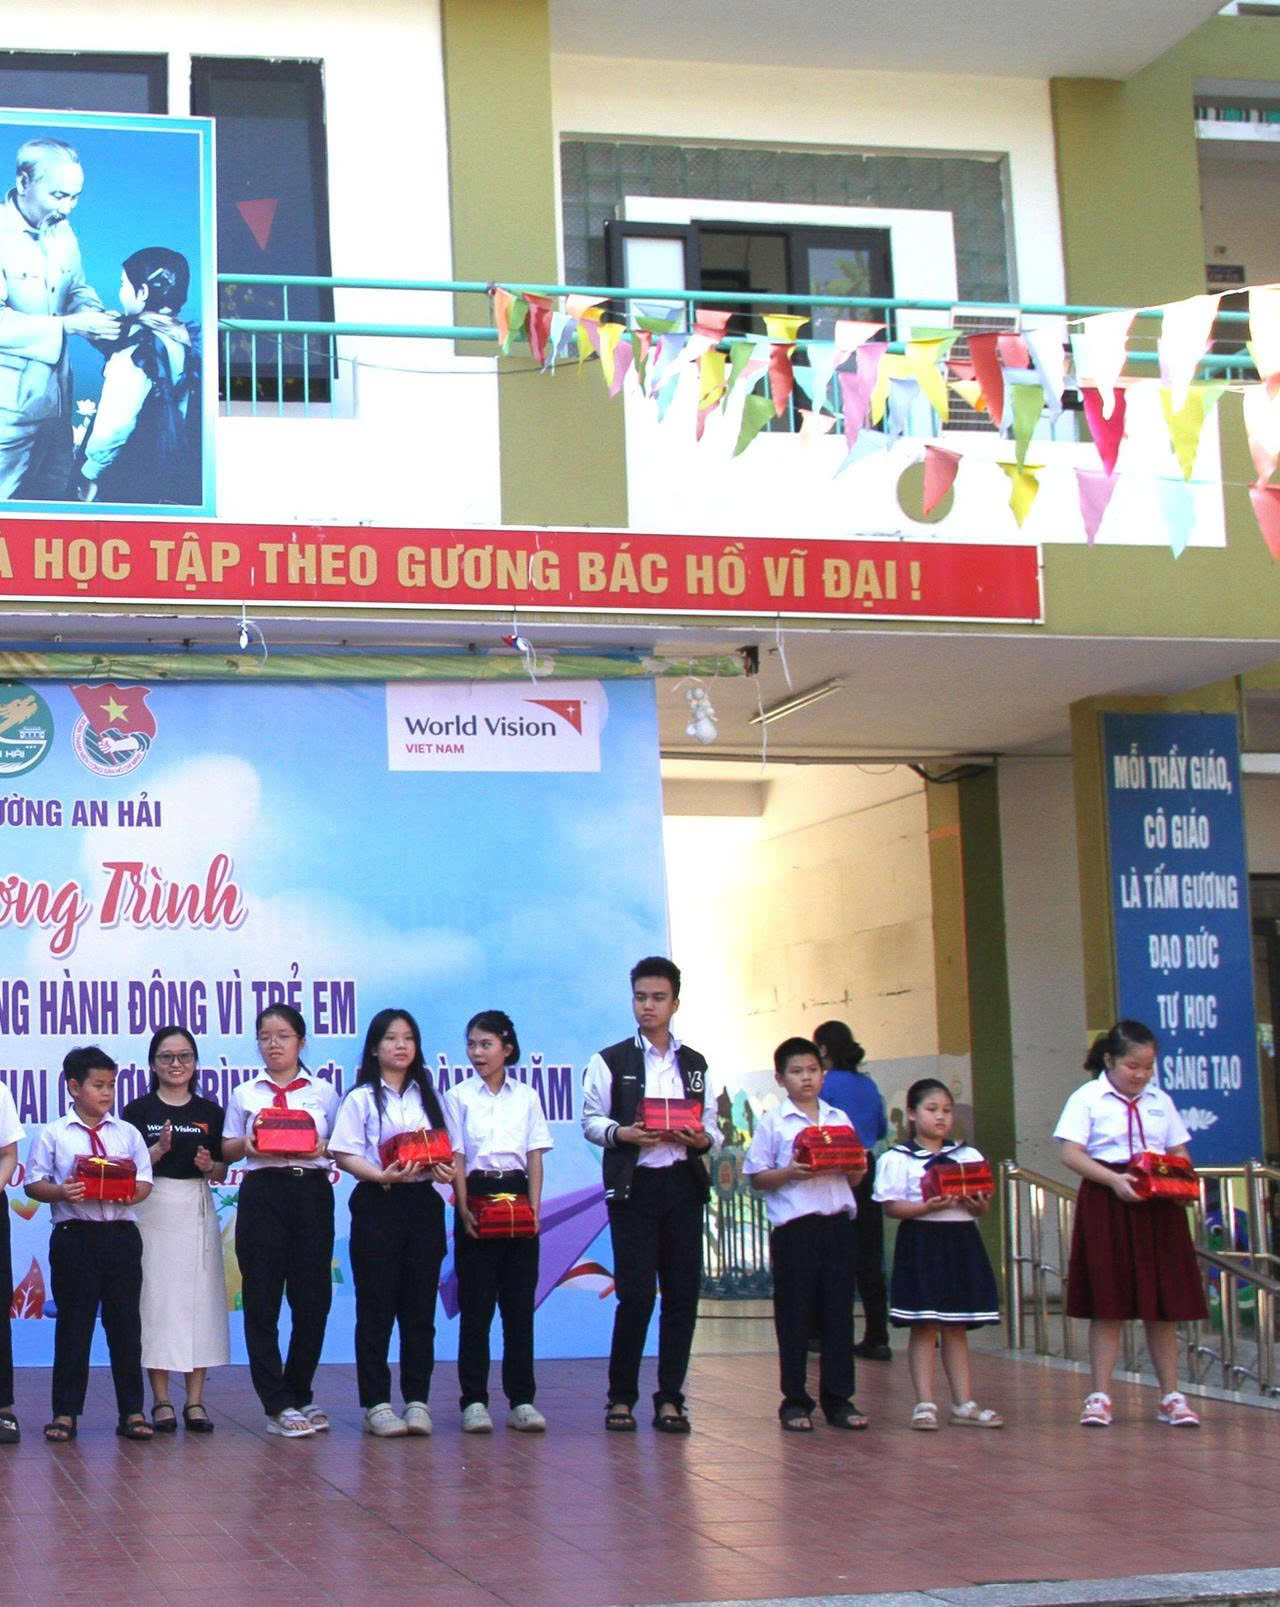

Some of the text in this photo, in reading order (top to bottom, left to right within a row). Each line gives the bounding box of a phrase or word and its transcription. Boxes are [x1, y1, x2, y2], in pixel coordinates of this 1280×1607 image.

[33, 538, 131, 590] HỌC
[149, 531, 241, 592] TẬP
[258, 542, 378, 587] THEO
[396, 542, 562, 592] GƯƠNG
[577, 543, 669, 594] BÁC
[685, 543, 747, 596] HỒ
[762, 548, 808, 597] VĨ
[405, 715, 557, 737] World Vision
[405, 743, 465, 754] VIET NAM
[1190, 748, 1232, 794] GIÁO,
[72, 800, 108, 827] AN
[117, 791, 161, 827] HẢI
[1143, 807, 1210, 849] CÔ GIÁO
[100, 853, 247, 925] Trình
[1121, 863, 1239, 909] LÀ TẤM GƯƠNG
[1148, 925, 1220, 976] ĐẠO ĐỨC
[40, 969, 119, 1035] HÀNH
[216, 969, 243, 1035] VÌ
[313, 981, 356, 1035] EM
[1157, 991, 1218, 1037] TỰ HỌC
[507, 1055, 573, 1121] ĂM
[1163, 1047, 1209, 1091] SÁNG
[1211, 1055, 1241, 1096] TẠO
[174, 1125, 201, 1134] Vision
